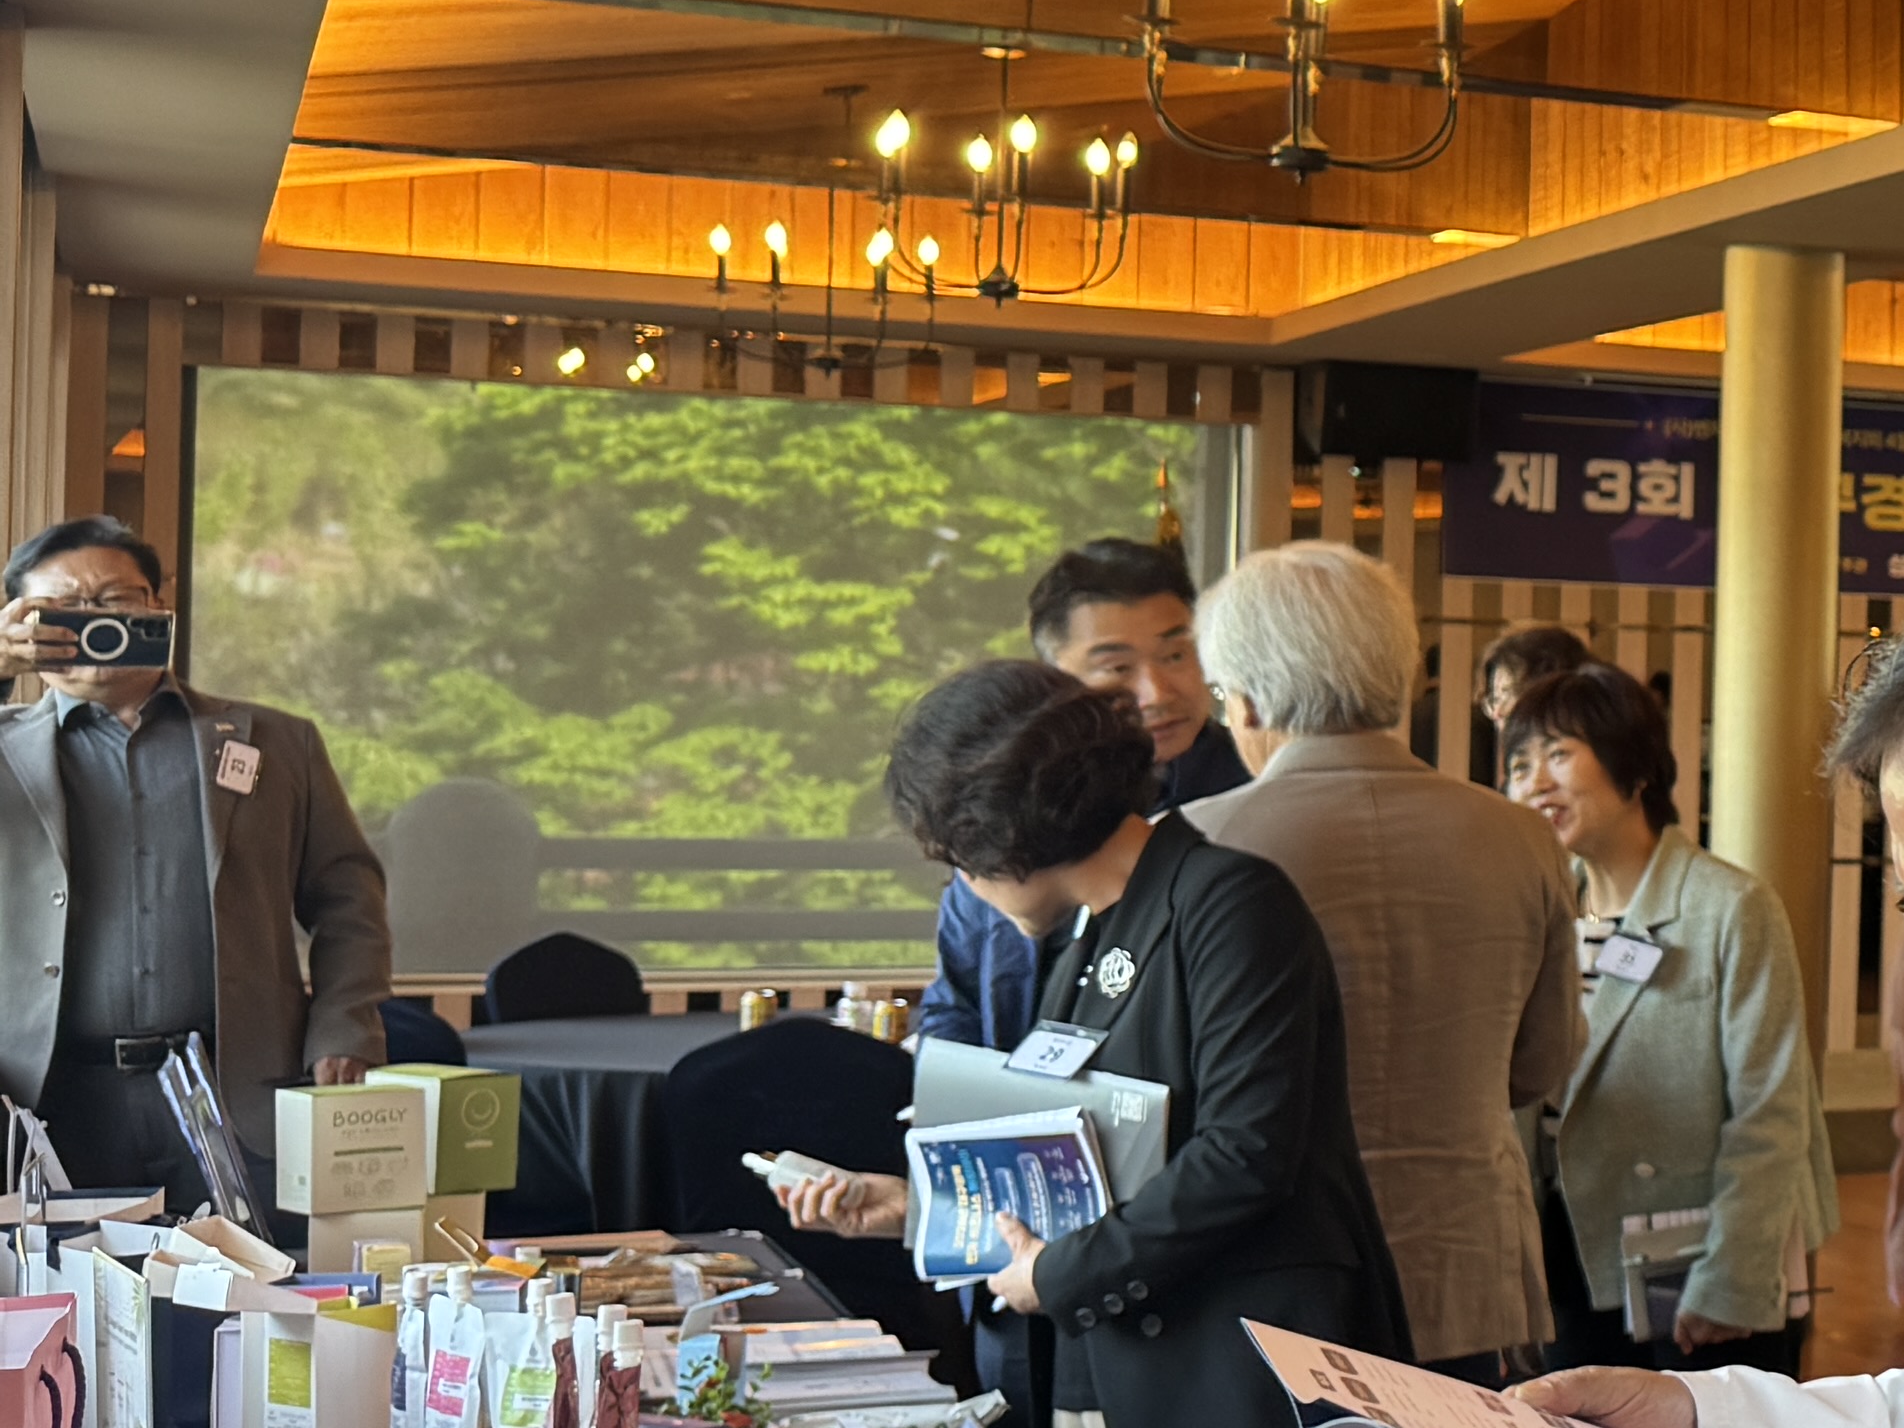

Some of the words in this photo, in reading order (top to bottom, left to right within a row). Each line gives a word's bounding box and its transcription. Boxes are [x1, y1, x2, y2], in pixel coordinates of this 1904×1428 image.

[1493, 450, 1558, 514] 제
[1583, 458, 1695, 521] 3회
[333, 1108, 408, 1127] BOOGLY
